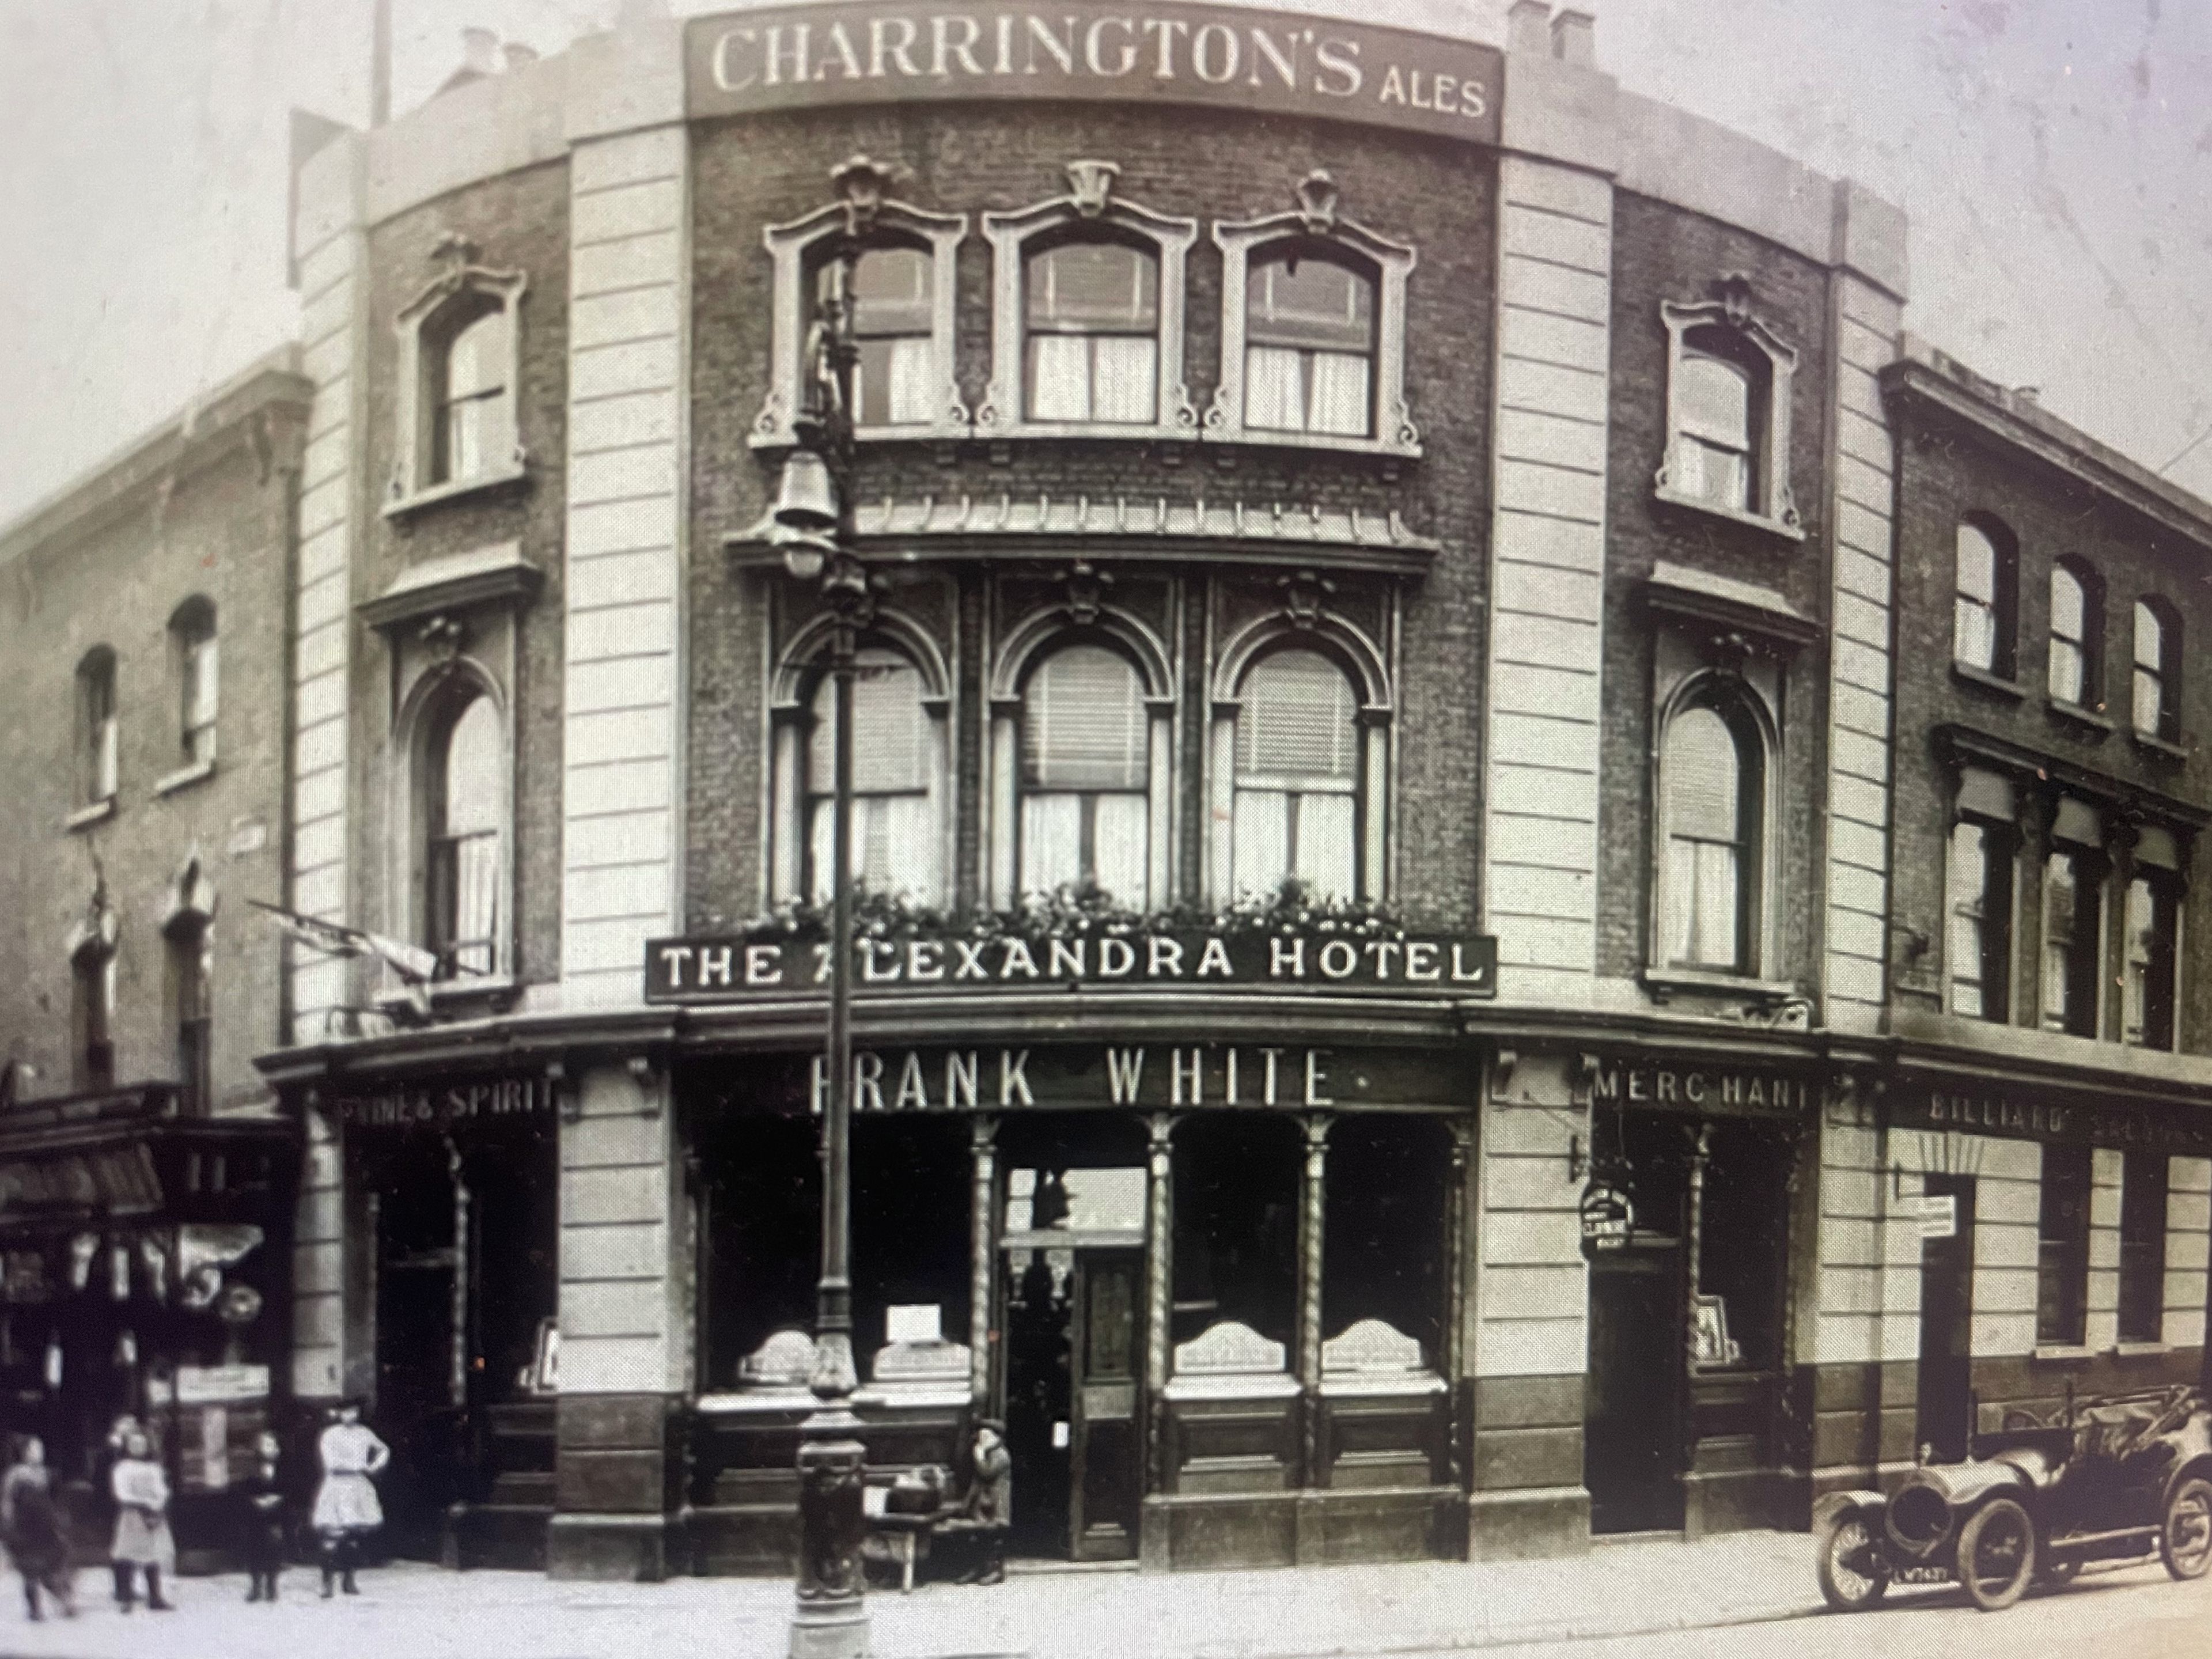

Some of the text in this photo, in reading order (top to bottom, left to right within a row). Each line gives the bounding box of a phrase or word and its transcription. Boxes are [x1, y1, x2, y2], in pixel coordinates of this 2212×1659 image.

[711, 15, 1487, 117] CHARRINGTON'S ALES
[660, 943, 782, 984] THE
[1270, 936, 1484, 981] HOTEL
[810, 1047, 1335, 1114] FRANK WHITE
